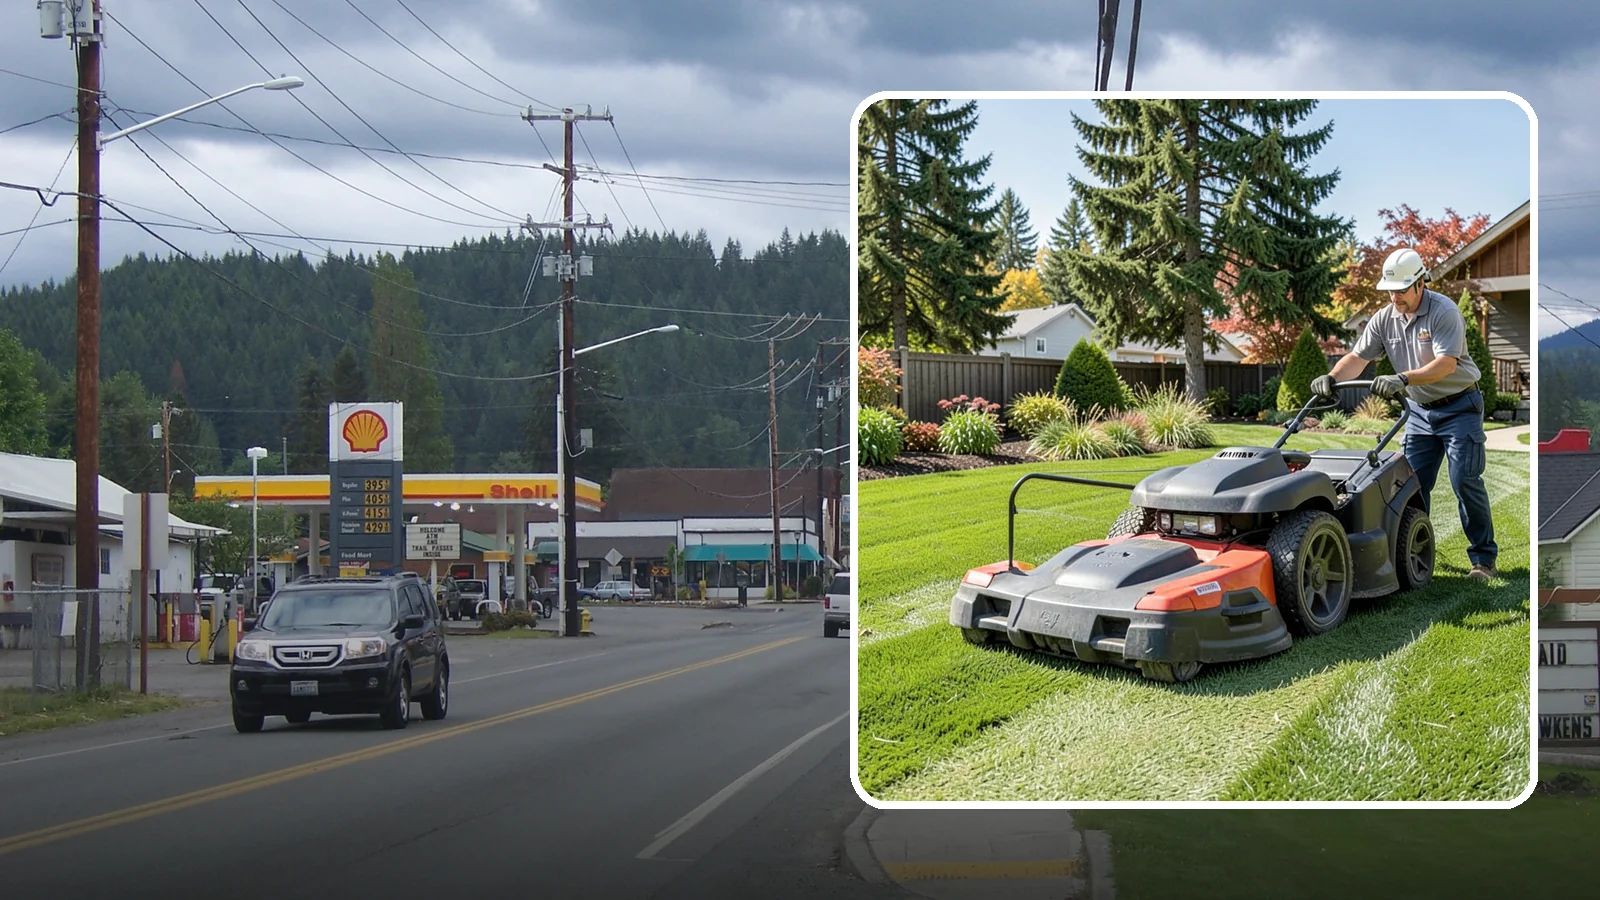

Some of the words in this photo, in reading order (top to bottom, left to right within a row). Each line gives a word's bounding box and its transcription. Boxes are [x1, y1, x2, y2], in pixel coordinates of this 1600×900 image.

[366, 480, 383, 490] 395
[490, 484, 547, 499] Shell
[366, 494, 383, 504] 405
[366, 508, 383, 518] 415
[366, 522, 383, 532] 429
[1539, 642, 1567, 665] AID
